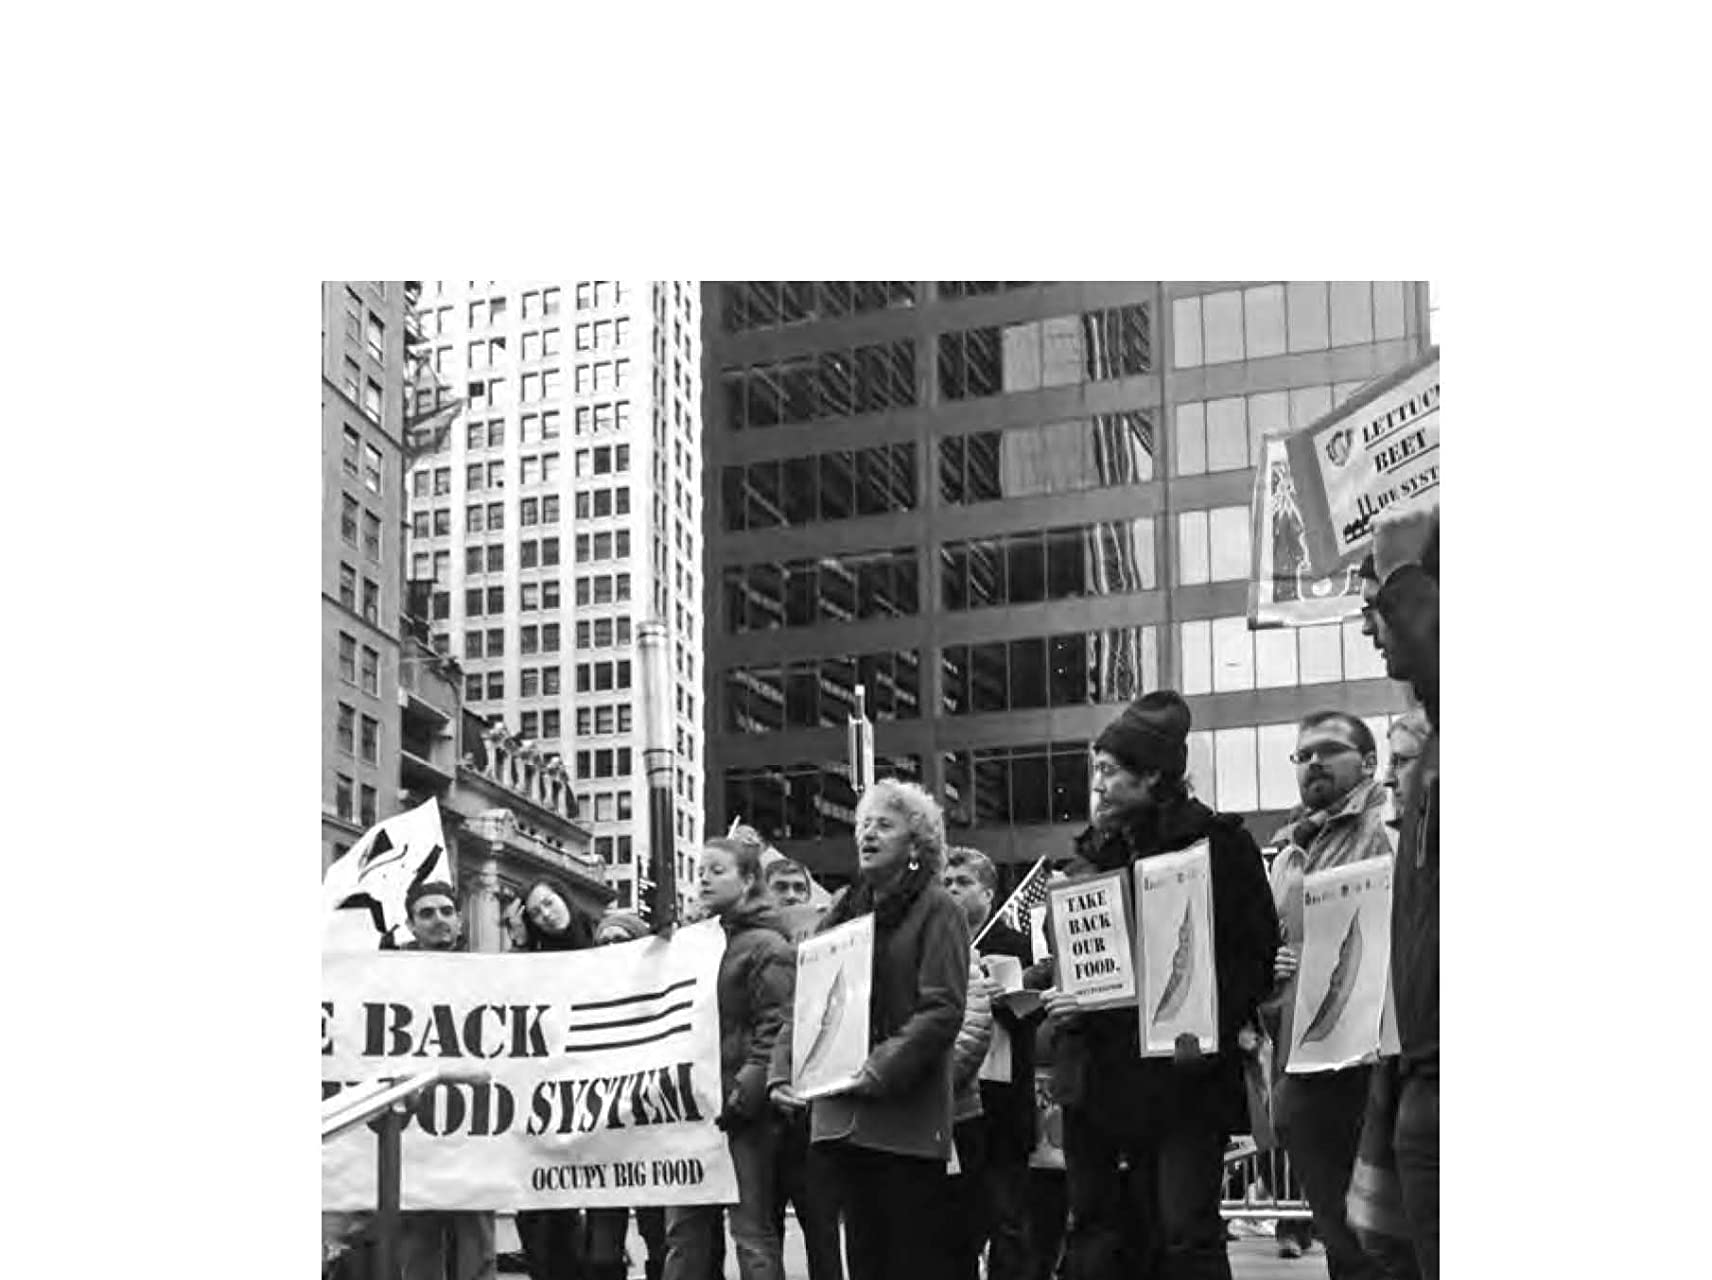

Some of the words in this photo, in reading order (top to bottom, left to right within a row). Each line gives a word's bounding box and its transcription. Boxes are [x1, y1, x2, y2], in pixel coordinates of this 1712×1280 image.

[1375, 427, 1427, 473] BEET
[1066, 889, 1108, 914] TAKE
[1068, 911, 1112, 936] BACK
[1071, 936, 1106, 957] OUR
[1074, 957, 1121, 981] FOOD.
[361, 1002, 551, 1059] BACK
[526, 1061, 705, 1137] SYSTEM
[531, 1163, 607, 1192] OCCUPY
[613, 1160, 647, 1188] BIG
[651, 1158, 705, 1187] FOOD
